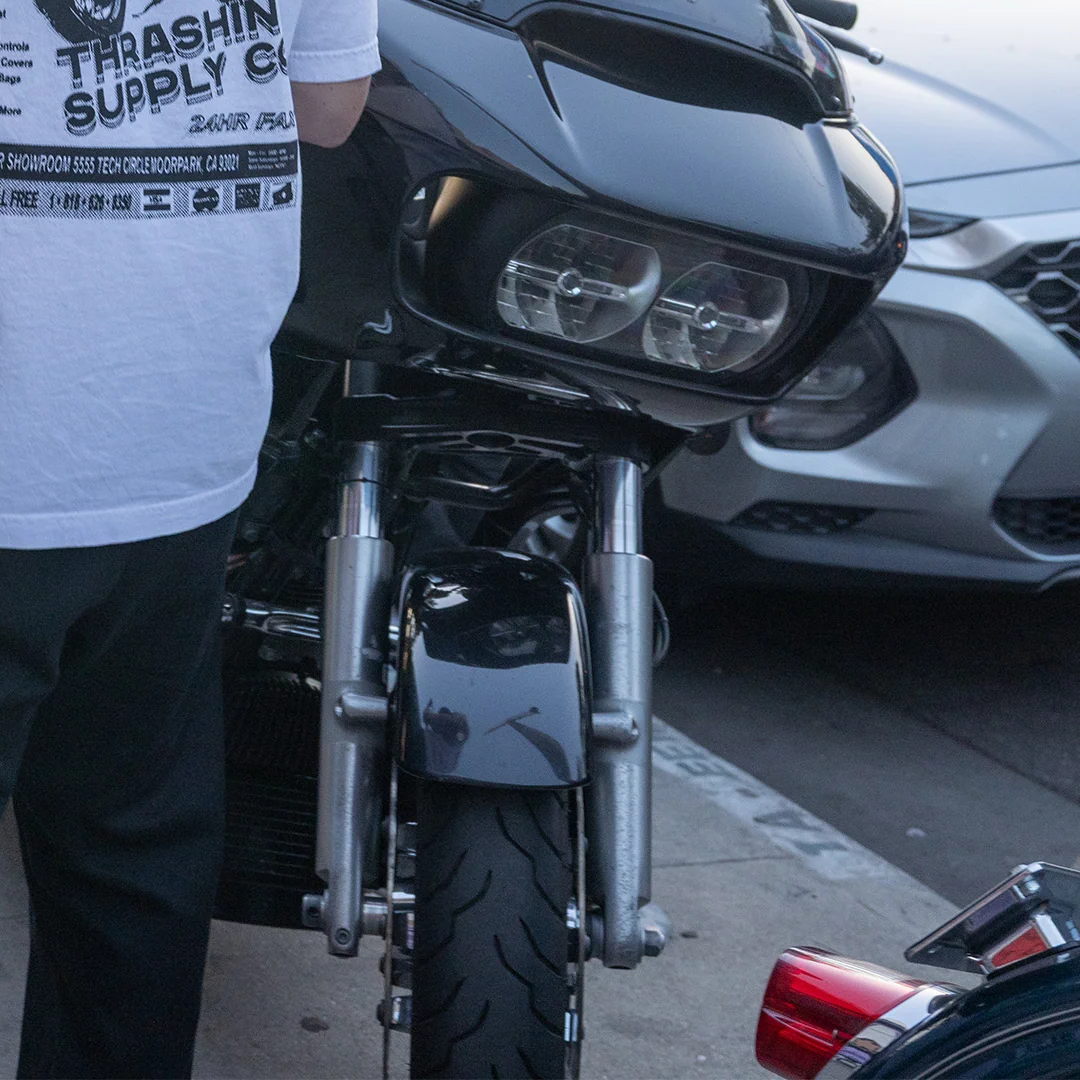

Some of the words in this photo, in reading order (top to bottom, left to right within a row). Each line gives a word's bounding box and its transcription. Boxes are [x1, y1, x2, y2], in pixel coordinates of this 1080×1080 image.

[1, 56, 33, 68] Covers
[63, 52, 227, 137] SUPPLY
[188, 112, 249, 134] 24HR
[6, 152, 71, 173] SHOWROOM
[73, 155, 95, 174] 5555
[97, 156, 122, 175] TECH
[122, 156, 150, 175] CIRCLE
[205, 154, 218, 172] CA
[10, 190, 39, 208] FREE
